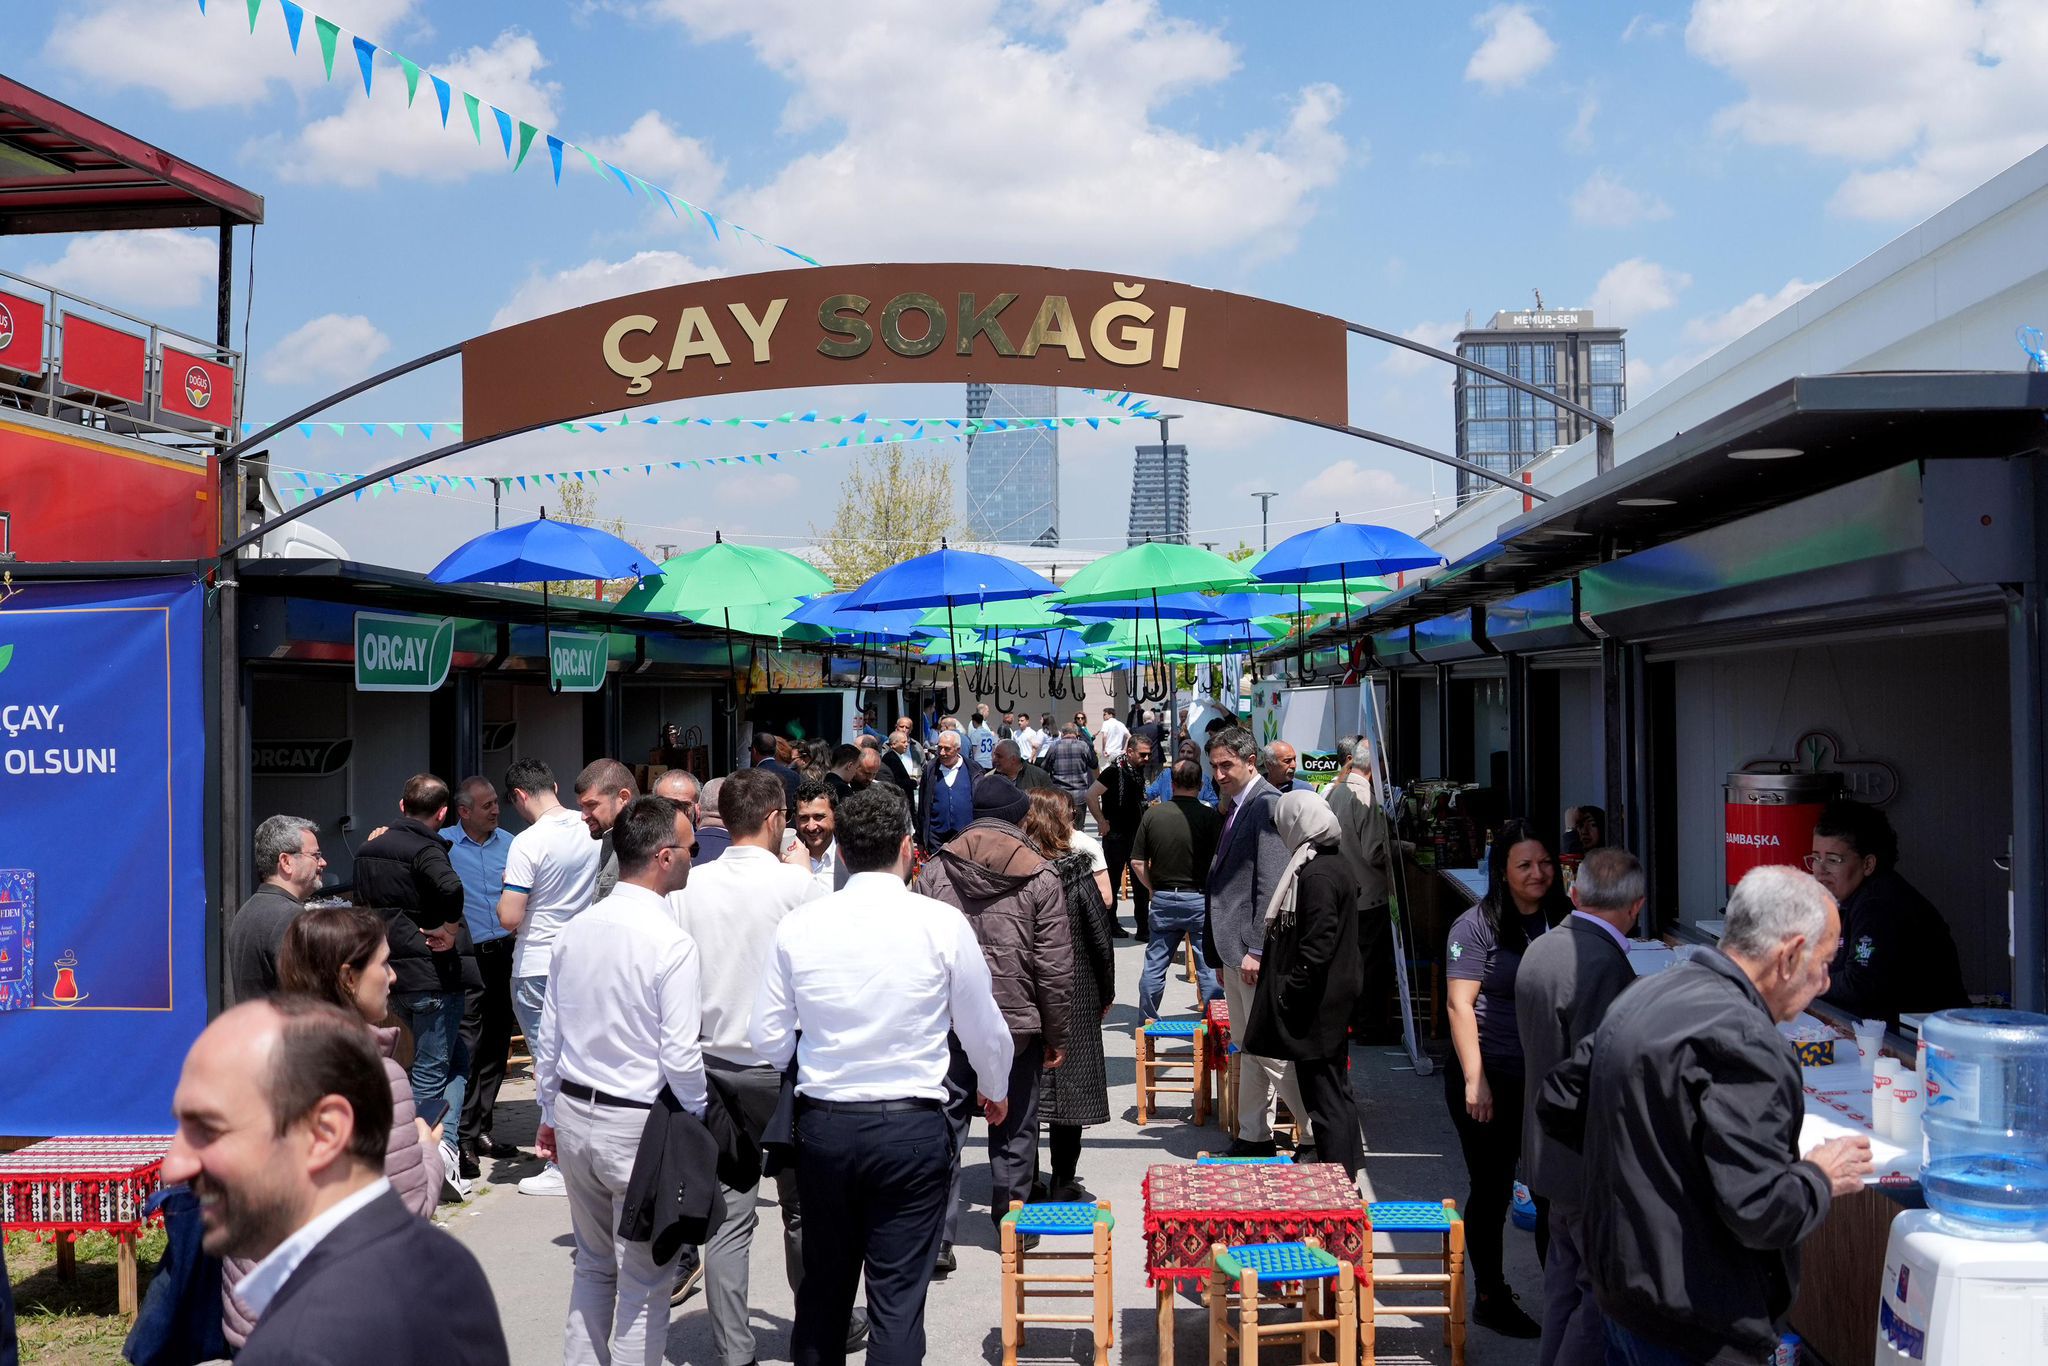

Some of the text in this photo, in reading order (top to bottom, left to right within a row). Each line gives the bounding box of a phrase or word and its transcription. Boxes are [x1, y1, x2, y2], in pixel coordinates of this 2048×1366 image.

[1513, 314, 1579, 325] MEMUR-SEN
[602, 281, 1187, 395] ÇAY SOKAĞI
[189, 374, 208, 389] DOĞUŞ
[363, 632, 428, 671] ORÇAY
[0, 705, 64, 737] ÇAY,
[980, 738, 993, 753] 53
[4, 748, 116, 775] OLSUN!
[1304, 760, 1337, 771] OFÇAY
